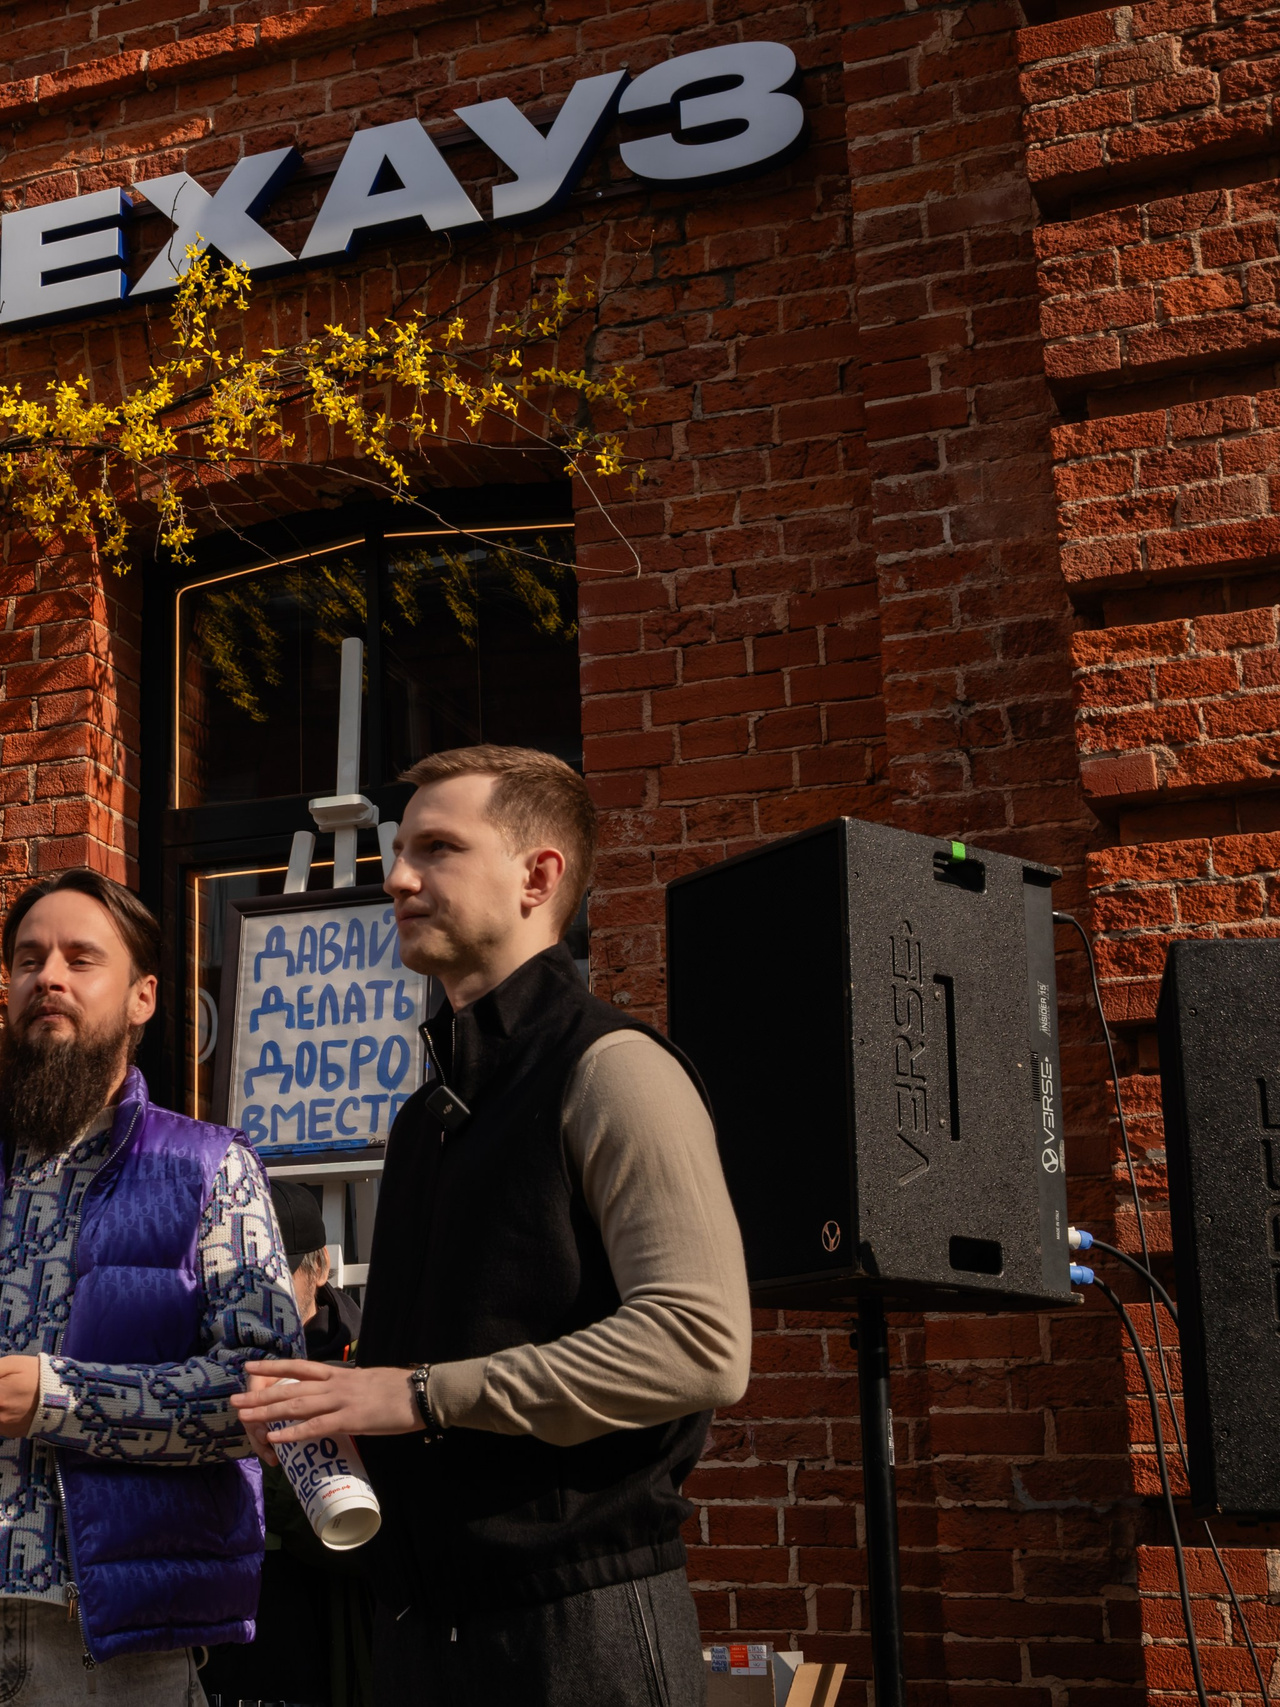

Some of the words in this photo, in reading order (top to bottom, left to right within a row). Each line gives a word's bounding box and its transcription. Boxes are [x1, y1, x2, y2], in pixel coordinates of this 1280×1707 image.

[254, 908, 403, 983] ДАВАЙ
[249, 979, 415, 1033] ДЕЛАТЬ
[243, 1034, 411, 1098] ДОБРО
[1039, 1061, 1056, 1145] VERSE
